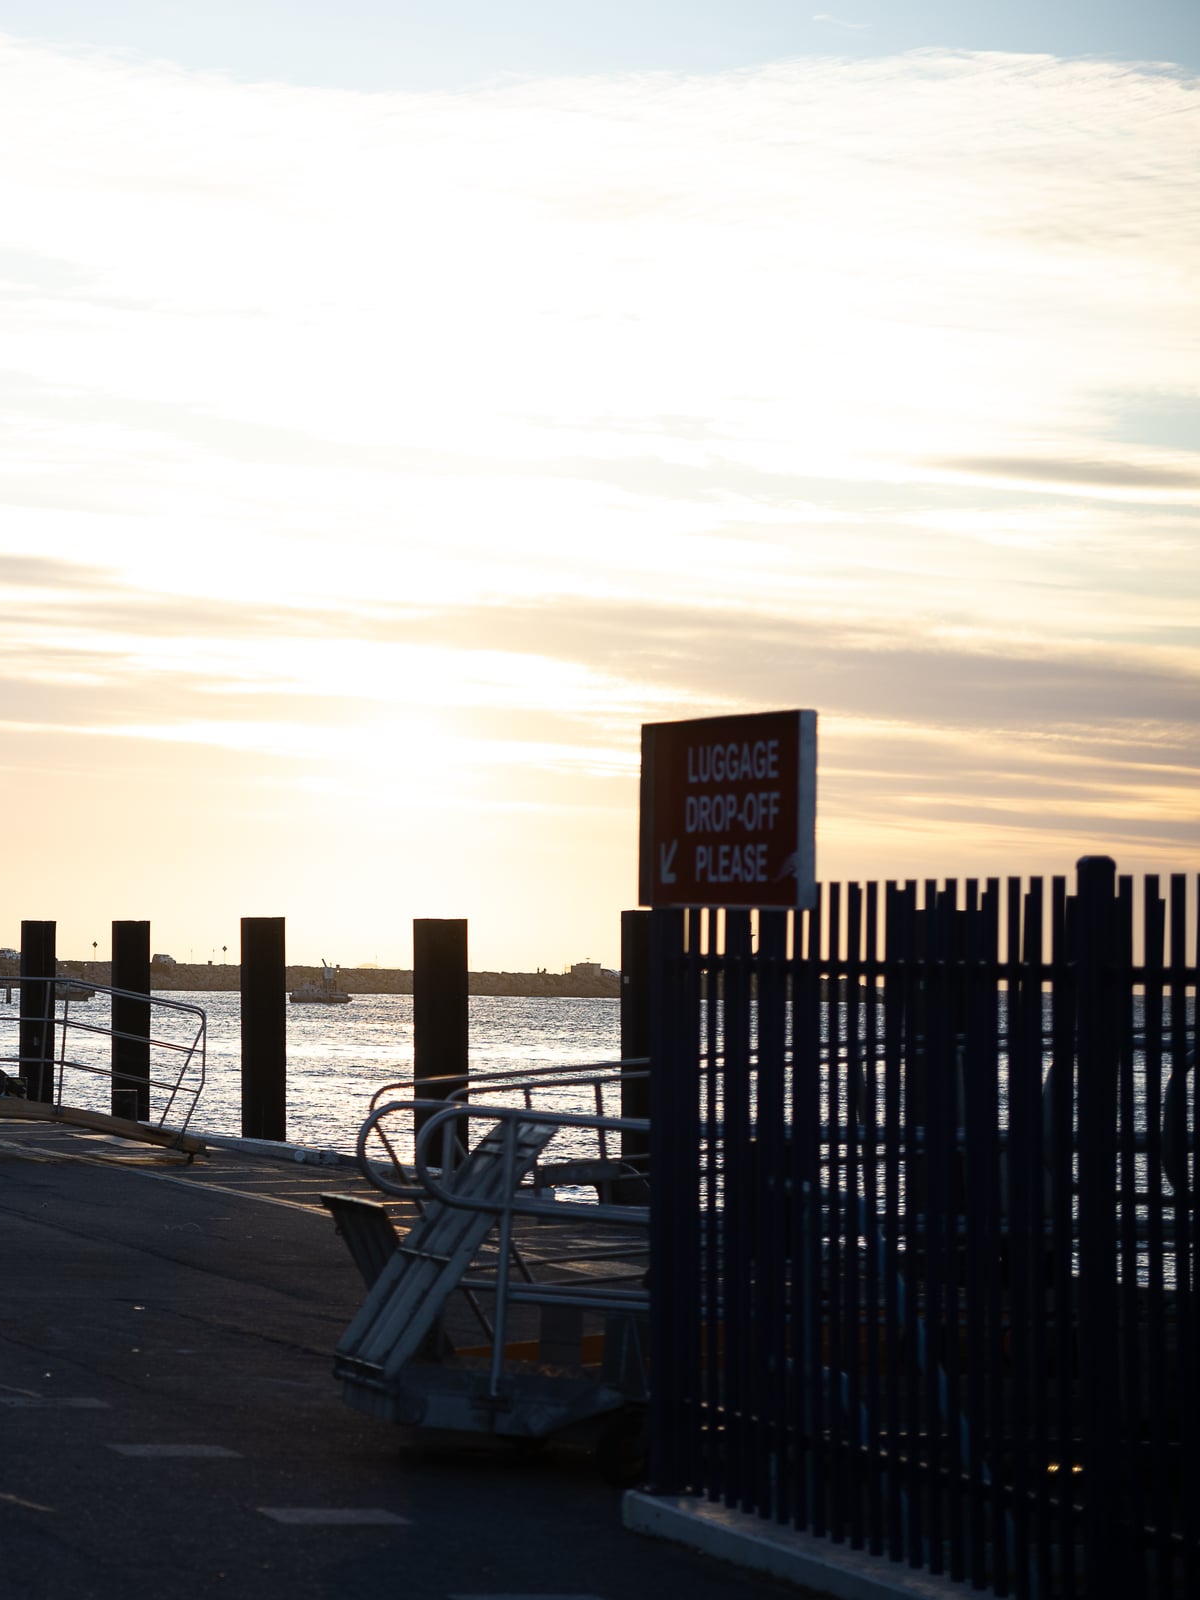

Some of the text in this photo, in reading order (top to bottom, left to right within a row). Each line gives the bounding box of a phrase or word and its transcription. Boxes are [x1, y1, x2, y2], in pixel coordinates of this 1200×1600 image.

[687, 739, 780, 784] LUGGAGE
[685, 791, 782, 833] DROP-OFF
[695, 843, 769, 883] PLEASE
